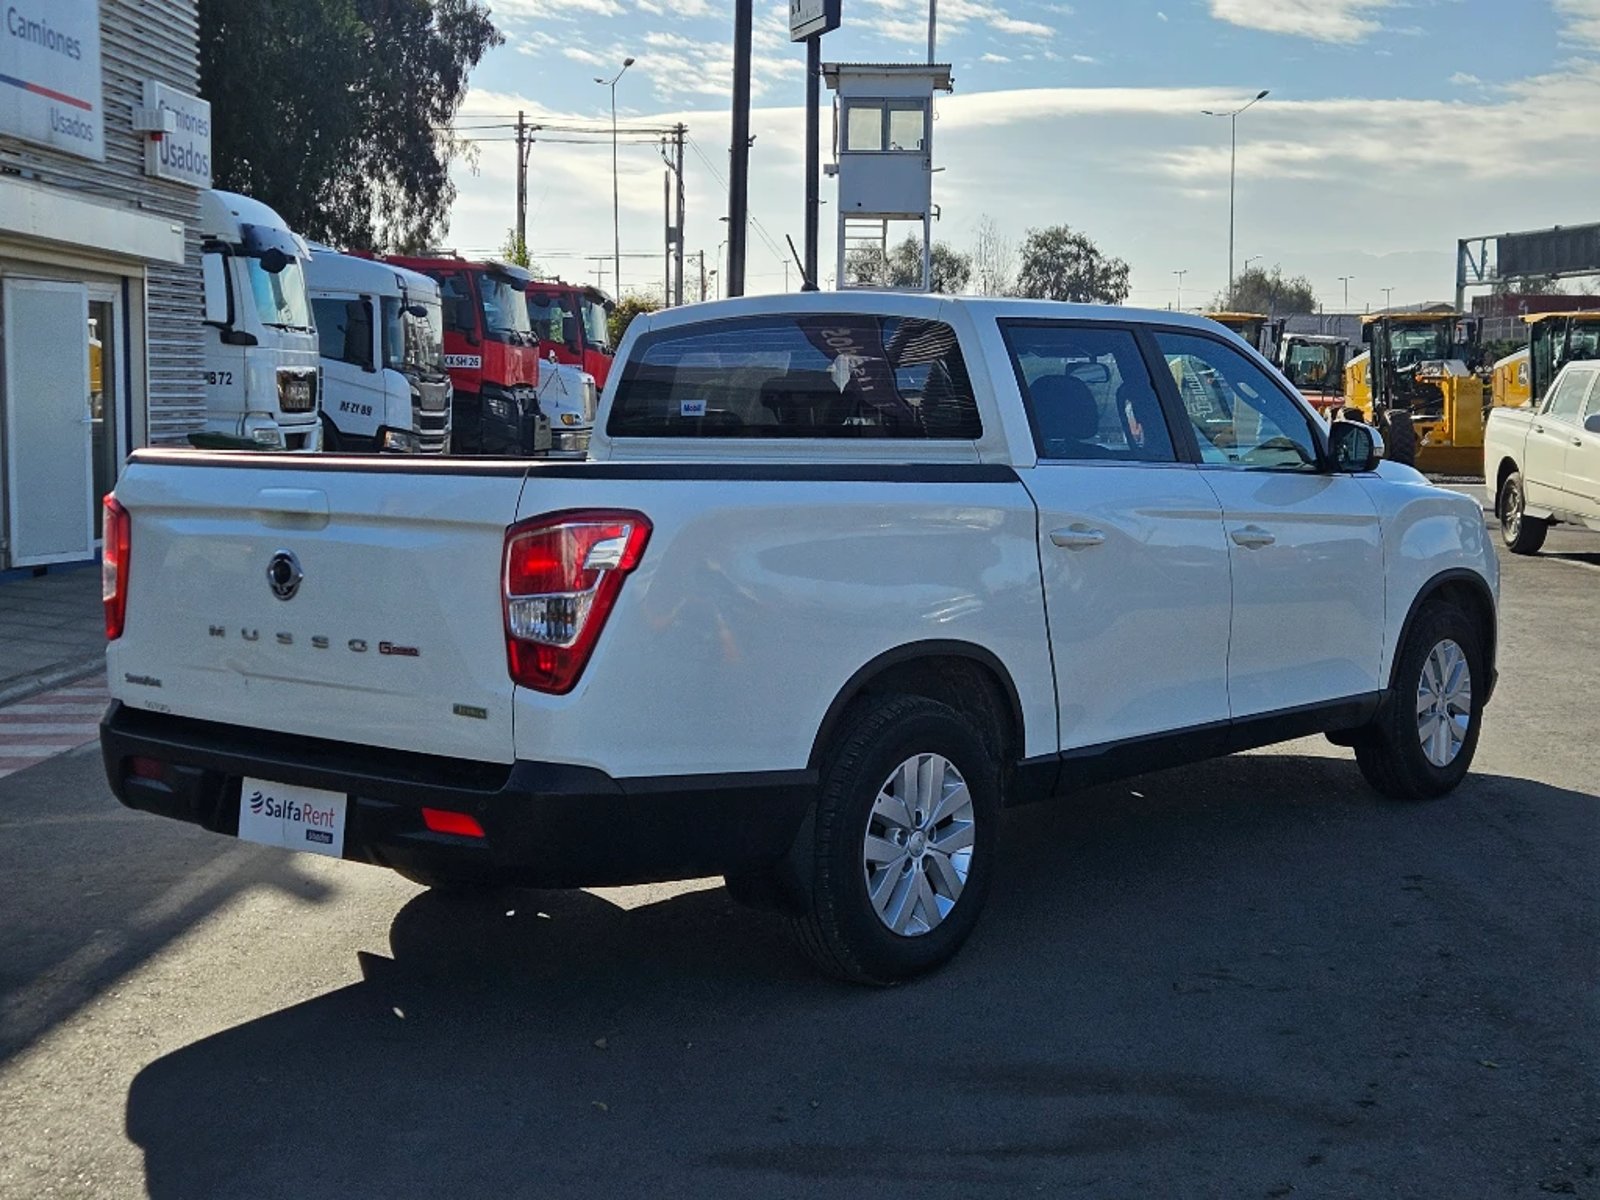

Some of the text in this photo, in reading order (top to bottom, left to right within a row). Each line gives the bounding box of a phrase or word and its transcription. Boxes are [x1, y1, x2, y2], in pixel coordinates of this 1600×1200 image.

[7, 6, 81, 60] Camiones
[50, 106, 94, 142] Usados
[160, 99, 209, 138] miones
[161, 133, 209, 176] Usados
[208, 624, 368, 653] MUSSO
[264, 796, 336, 829] SalfaRent
